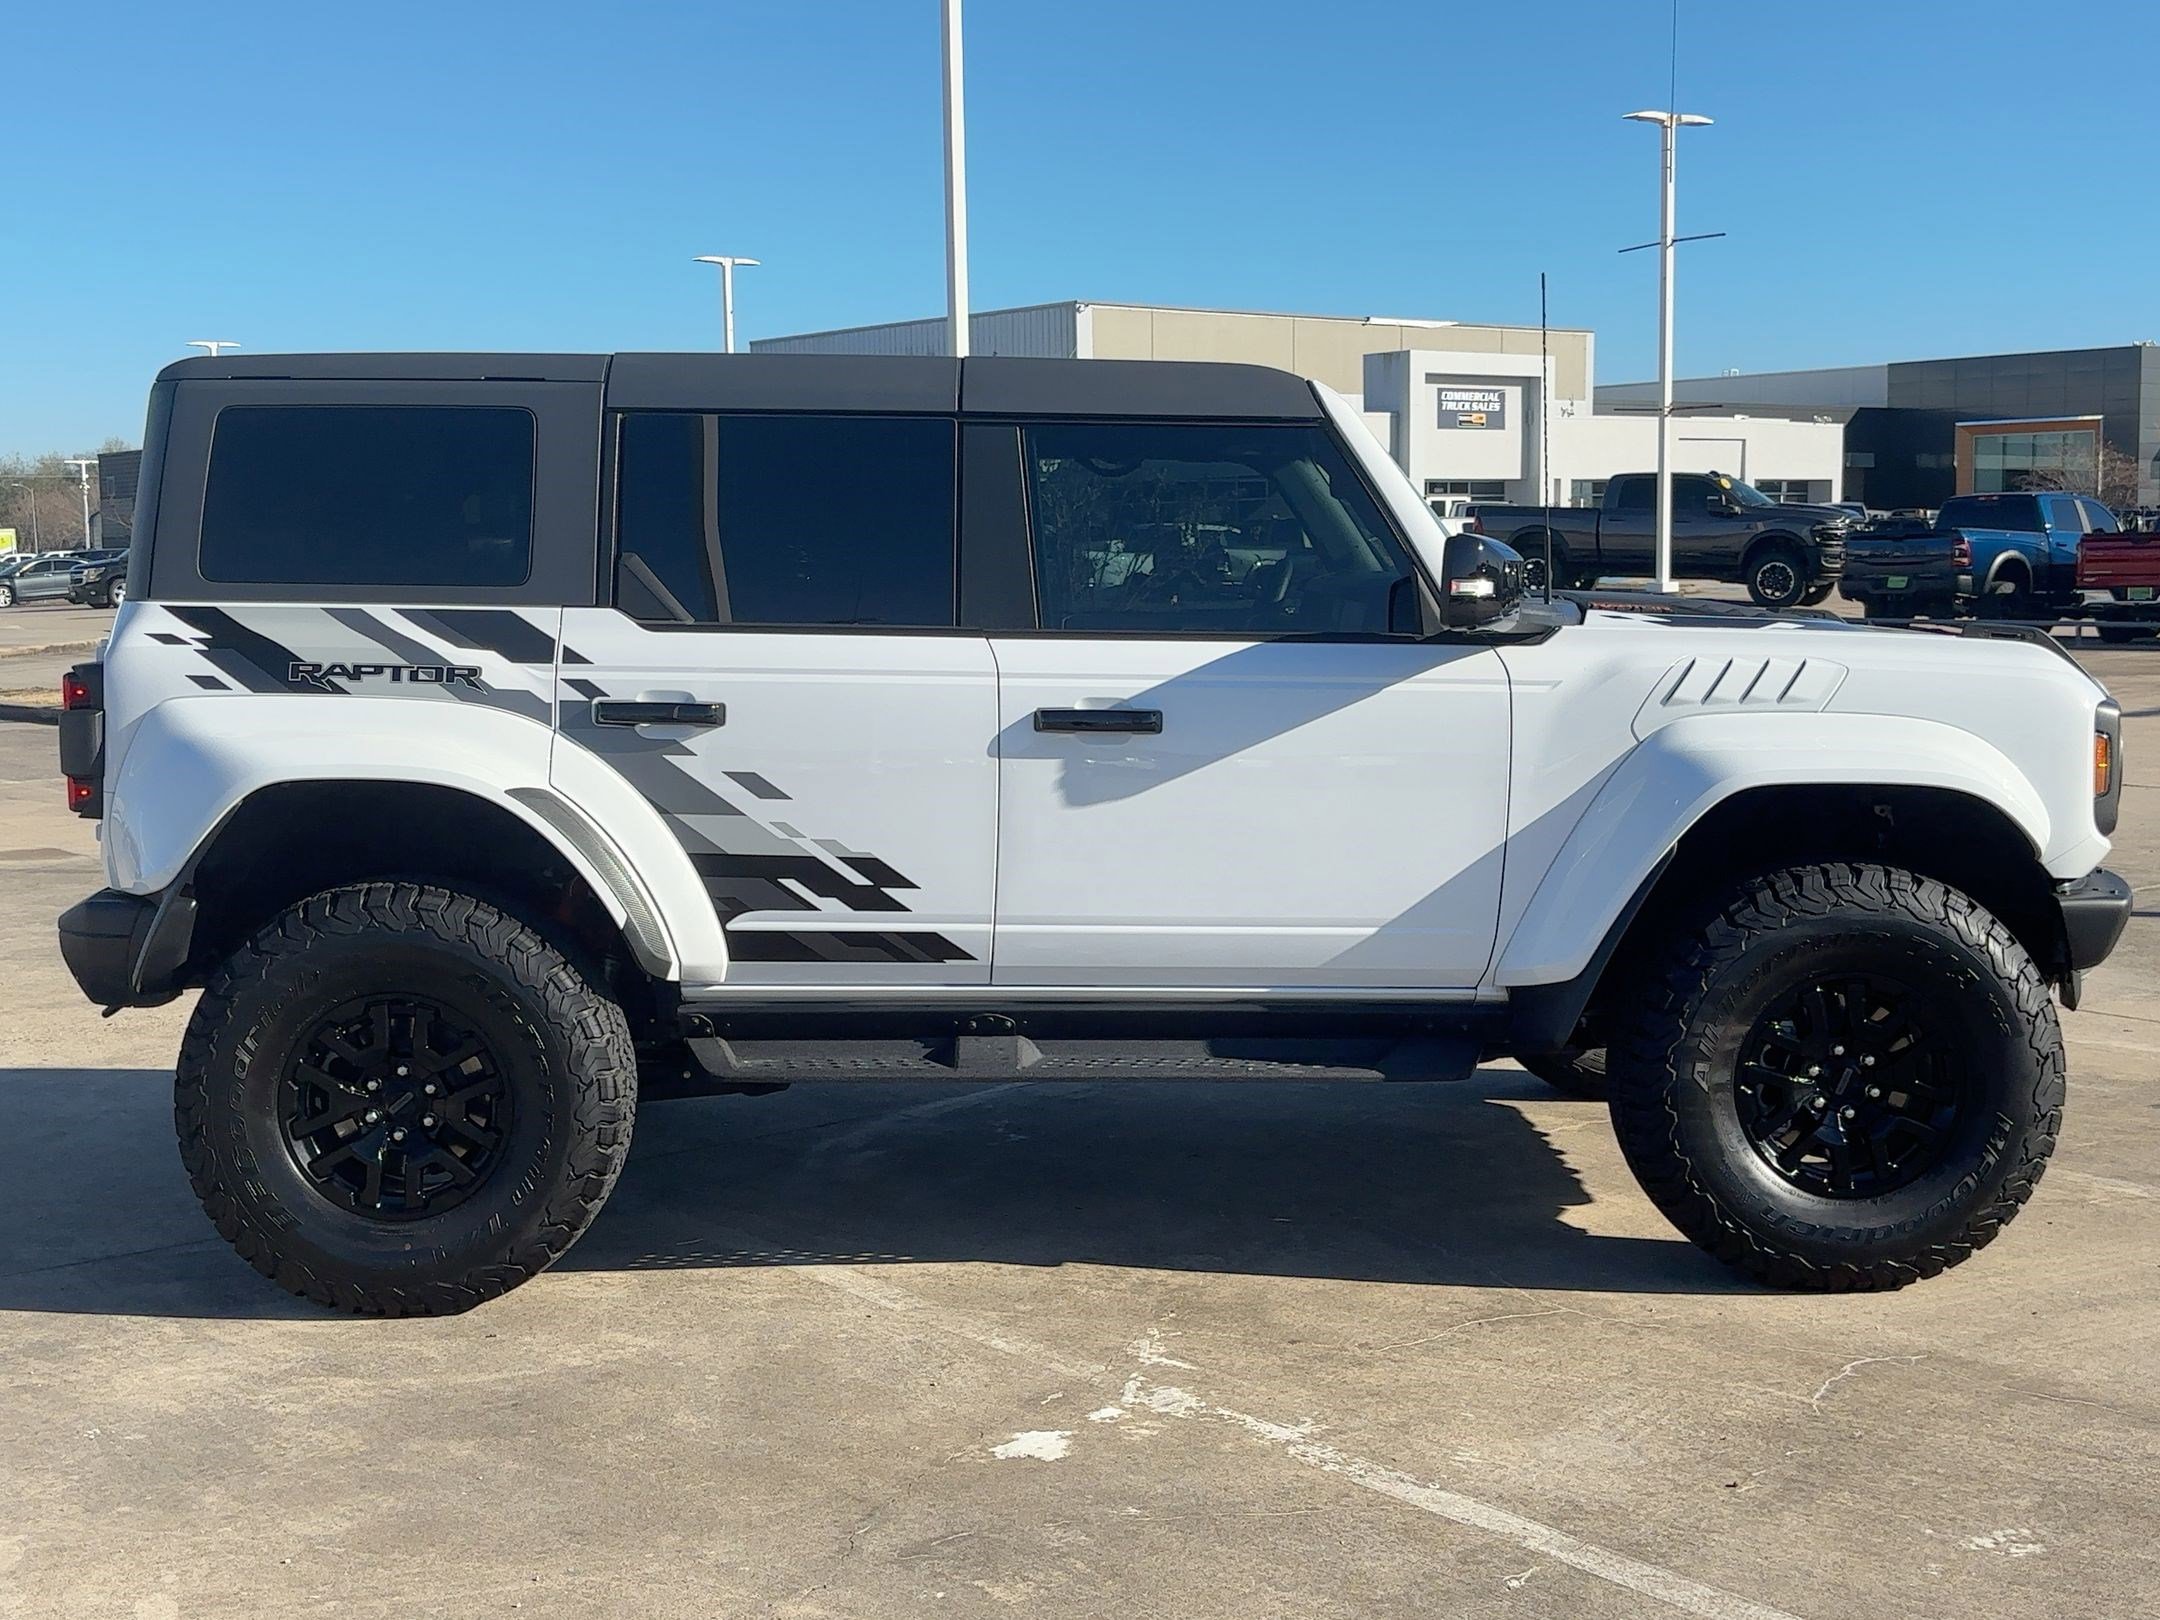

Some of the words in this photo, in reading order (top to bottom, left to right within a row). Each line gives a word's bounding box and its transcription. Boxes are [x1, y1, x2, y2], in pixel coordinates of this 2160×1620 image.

[1441, 391, 1500, 401] COMMERCIAL
[1441, 401, 1472, 411] TRUCK
[1471, 402, 1501, 411] SALES
[289, 662, 488, 695] RAPTOR
